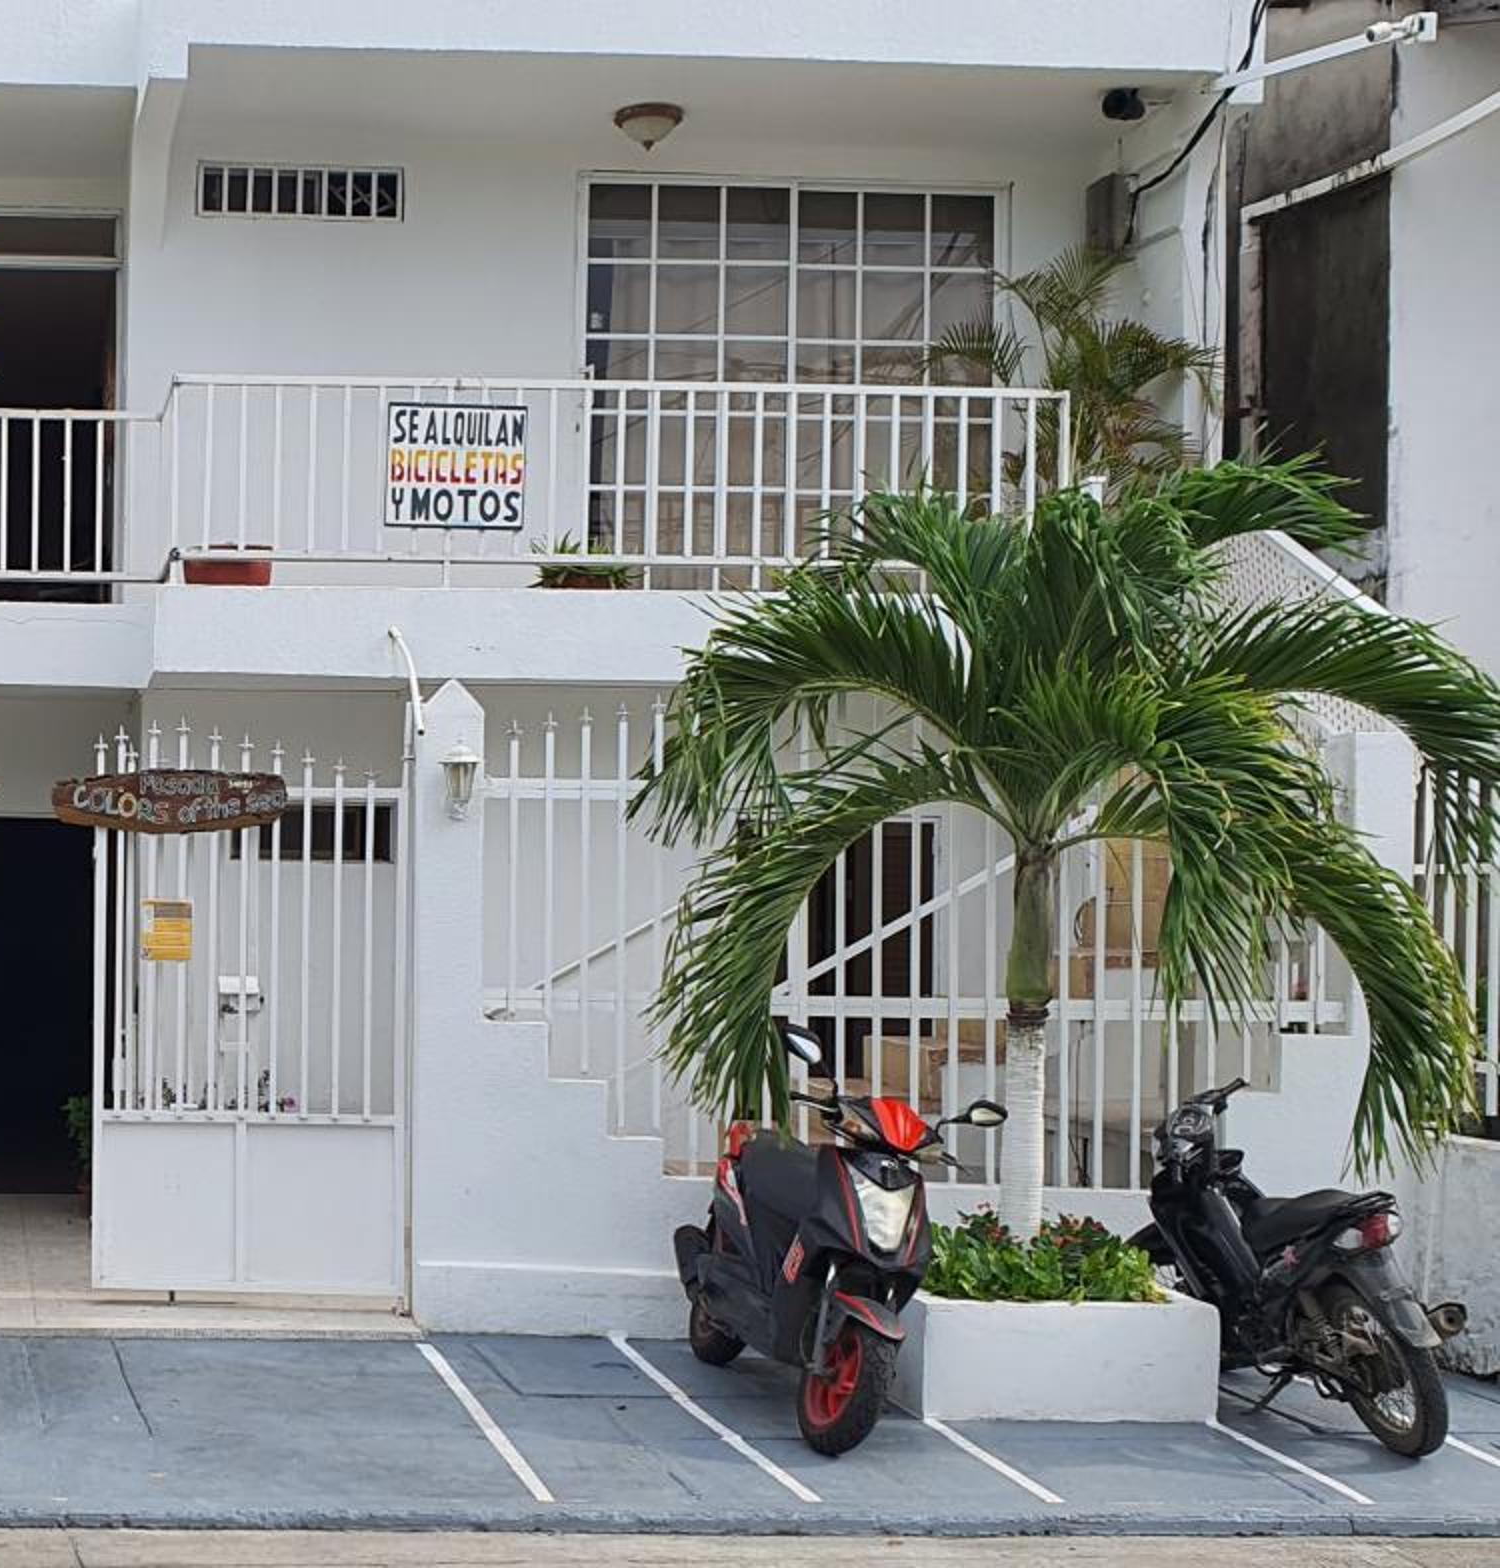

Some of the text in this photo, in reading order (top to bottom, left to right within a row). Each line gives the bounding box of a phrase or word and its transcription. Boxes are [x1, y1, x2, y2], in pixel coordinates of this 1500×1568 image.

[392, 409, 526, 447] SE ALQUILAN
[390, 448, 524, 485] BICICLETAS
[391, 487, 522, 523] Y MOTOS
[73, 786, 169, 824] COLORS
